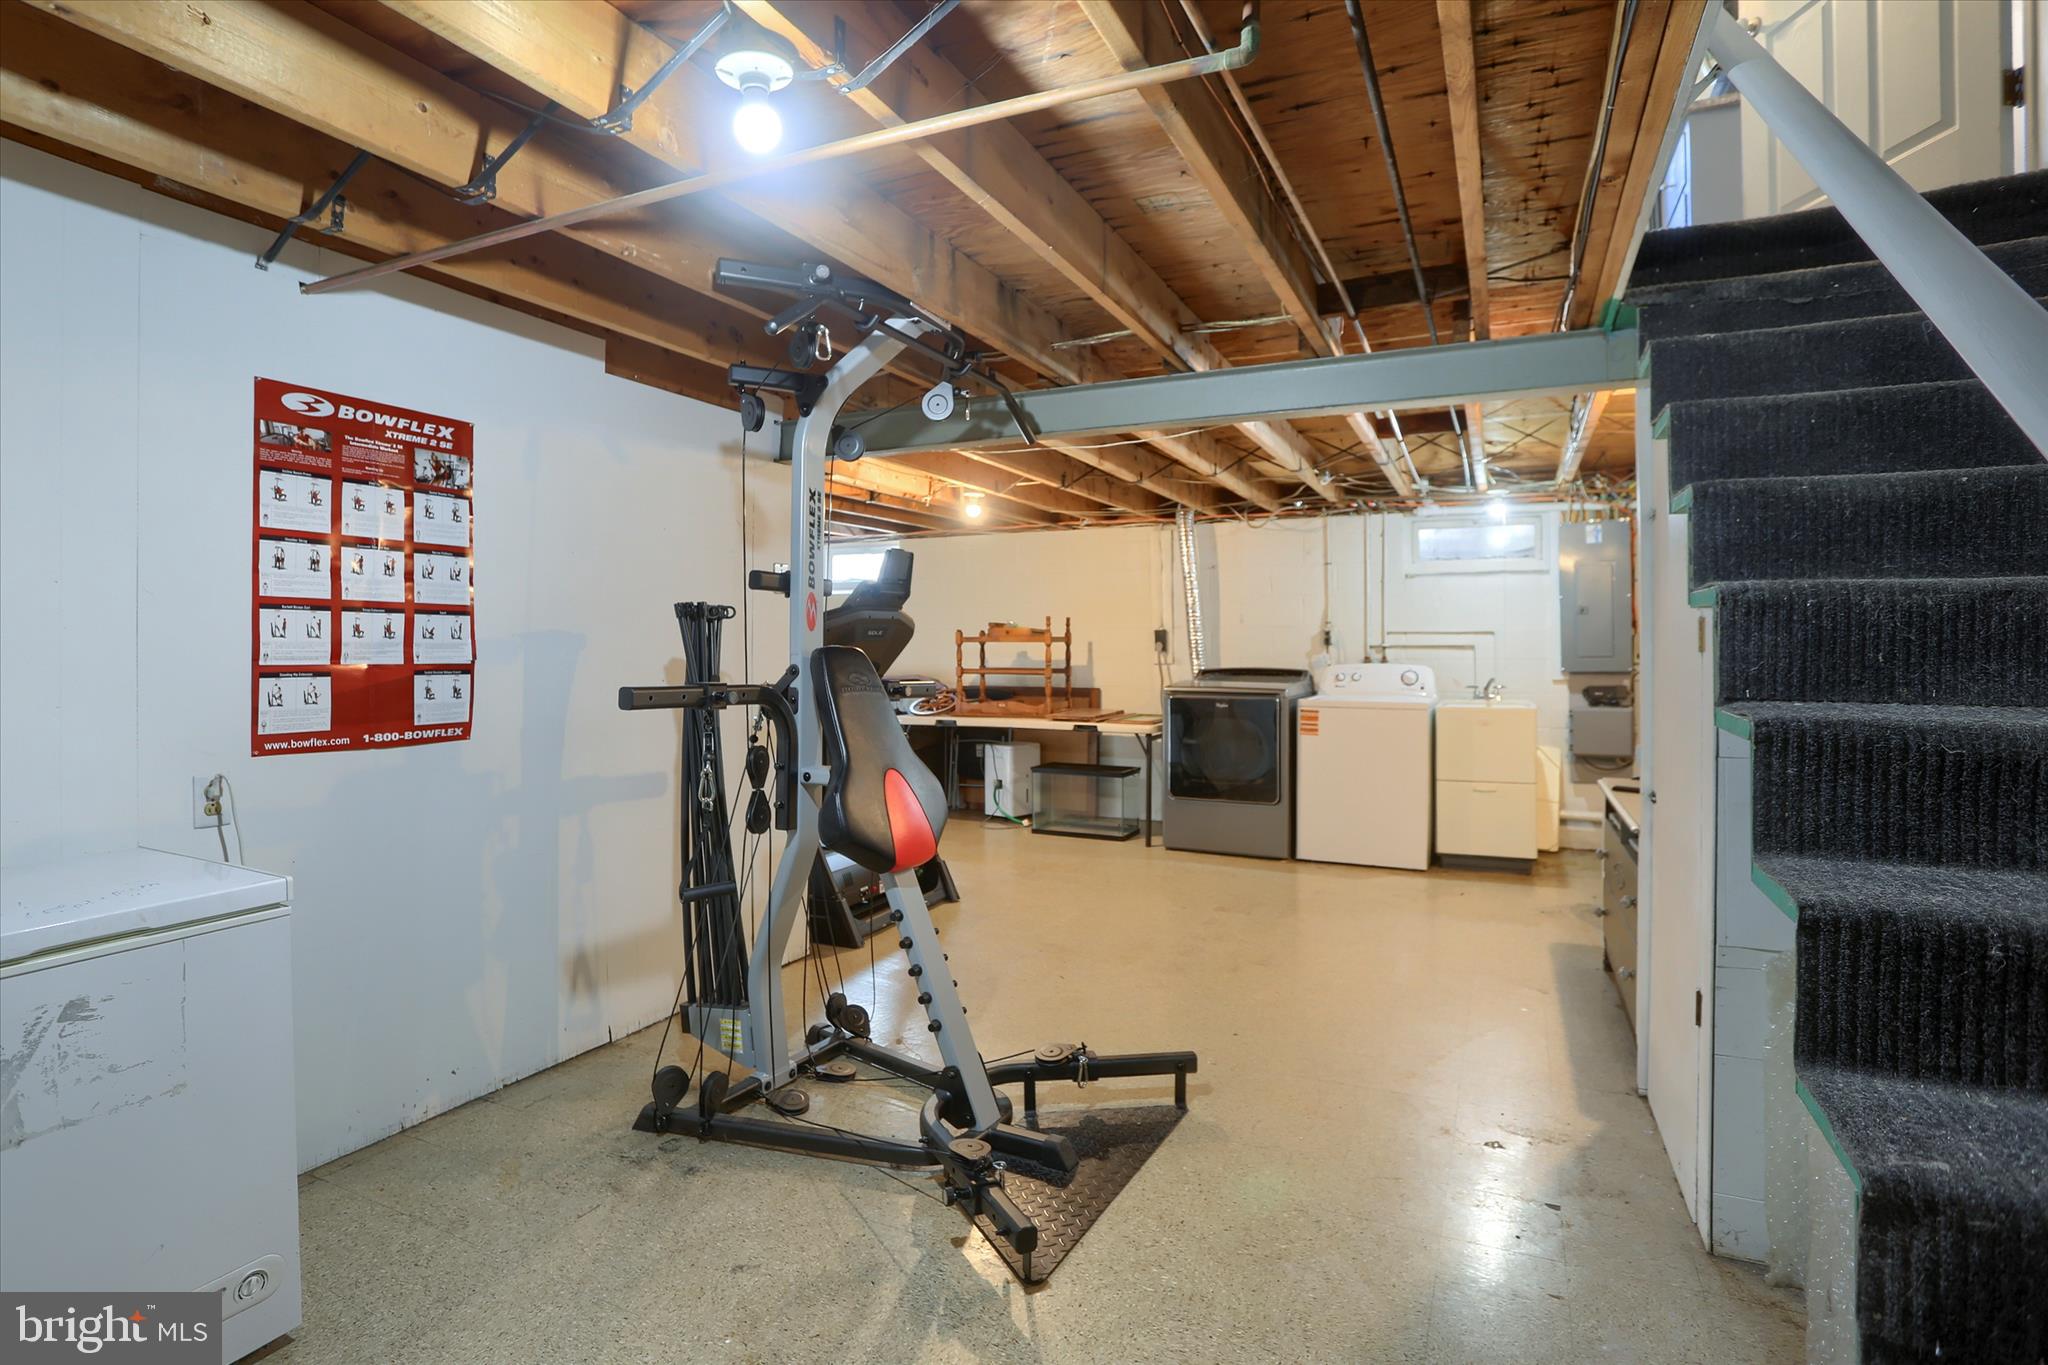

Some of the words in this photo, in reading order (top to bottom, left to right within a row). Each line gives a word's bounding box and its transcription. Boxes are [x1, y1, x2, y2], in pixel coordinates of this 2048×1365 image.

[337, 404, 456, 440] BOWFLEX
[384, 430, 428, 446] XTREME
[429, 439, 438, 447] 2
[439, 440, 453, 449] SE
[808, 487, 817, 590] BOWFLEX
[264, 737, 350, 750] www.bowflex.com
[363, 727, 464, 743] 1-800-BOWFLEX
